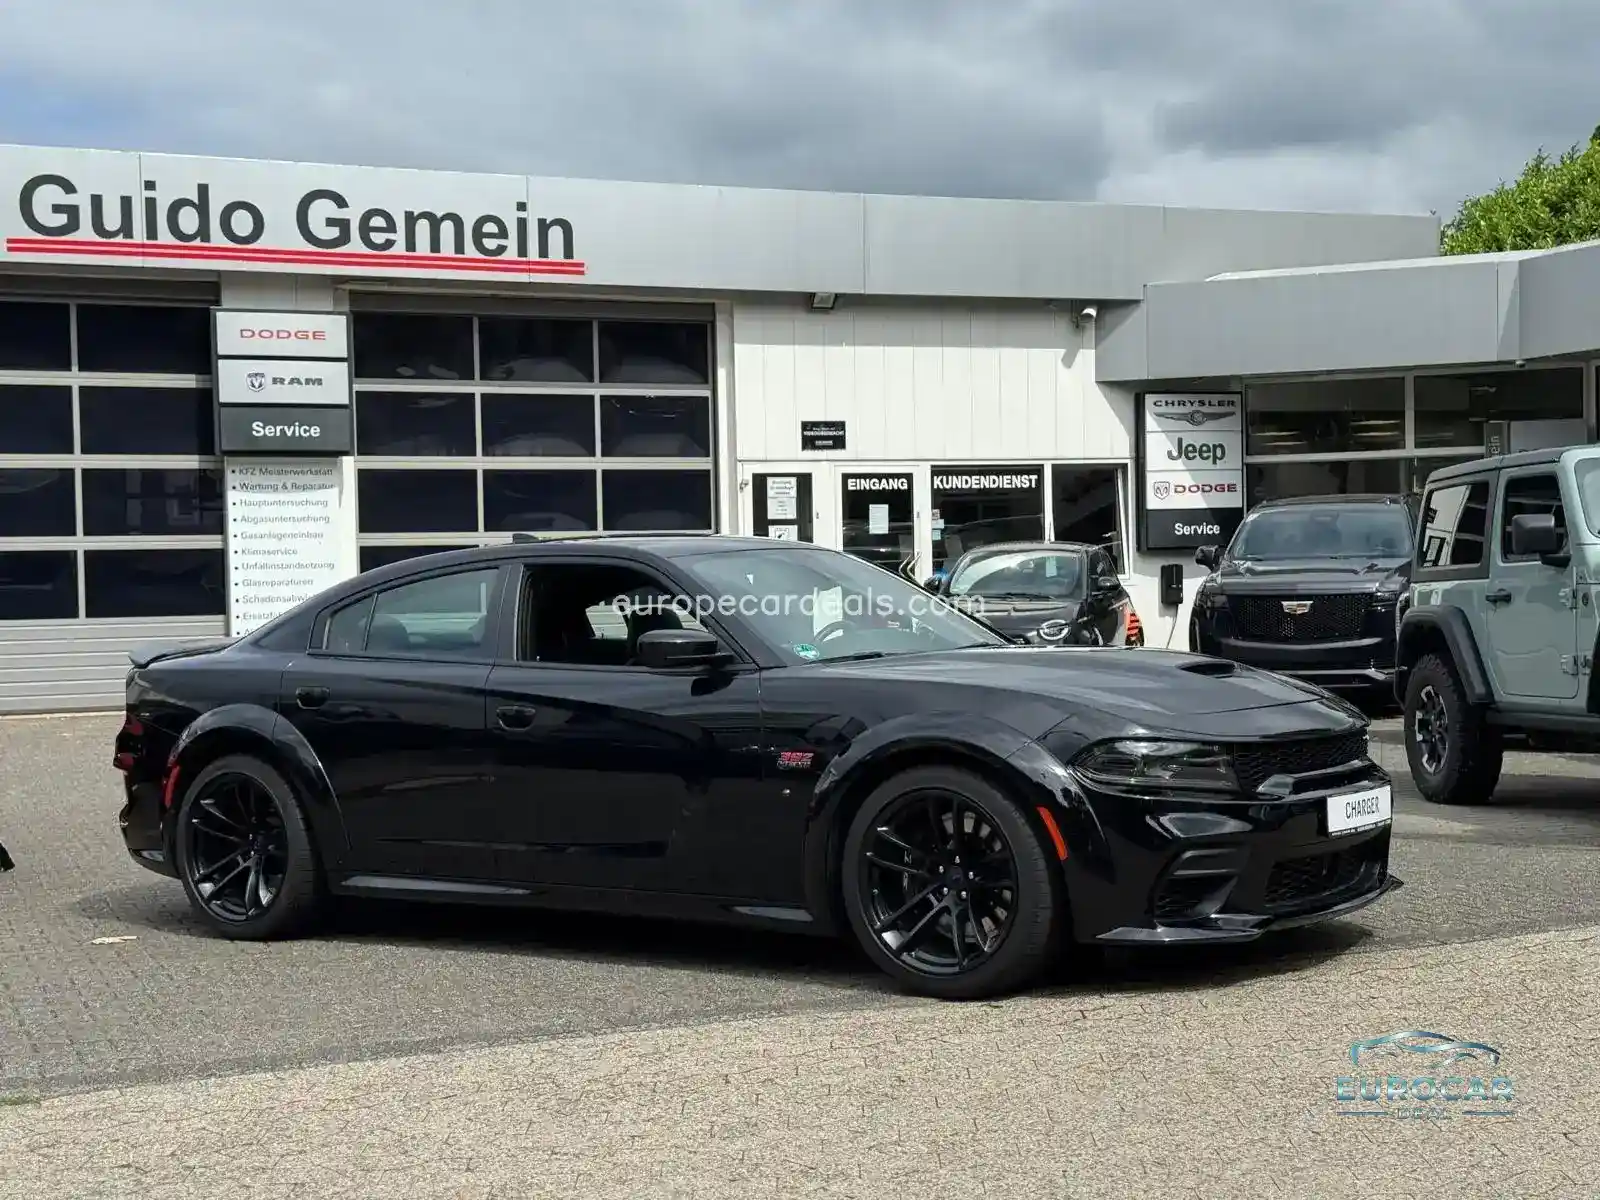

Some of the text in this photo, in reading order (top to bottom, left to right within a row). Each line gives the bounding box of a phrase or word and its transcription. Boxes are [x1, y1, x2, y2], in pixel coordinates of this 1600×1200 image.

[18, 173, 575, 260] Guido Gemein
[240, 328, 326, 340] DODGE
[272, 376, 323, 387] RAM
[1153, 399, 1237, 407] CHRYSLER
[251, 421, 321, 437] Service
[1167, 437, 1226, 465] Jeep
[847, 478, 908, 490] EINGANG
[933, 475, 1038, 489] KUNDENDIENST
[1174, 483, 1237, 493] DODGE
[1174, 522, 1220, 535] Service
[1345, 796, 1380, 819] CHARGER
